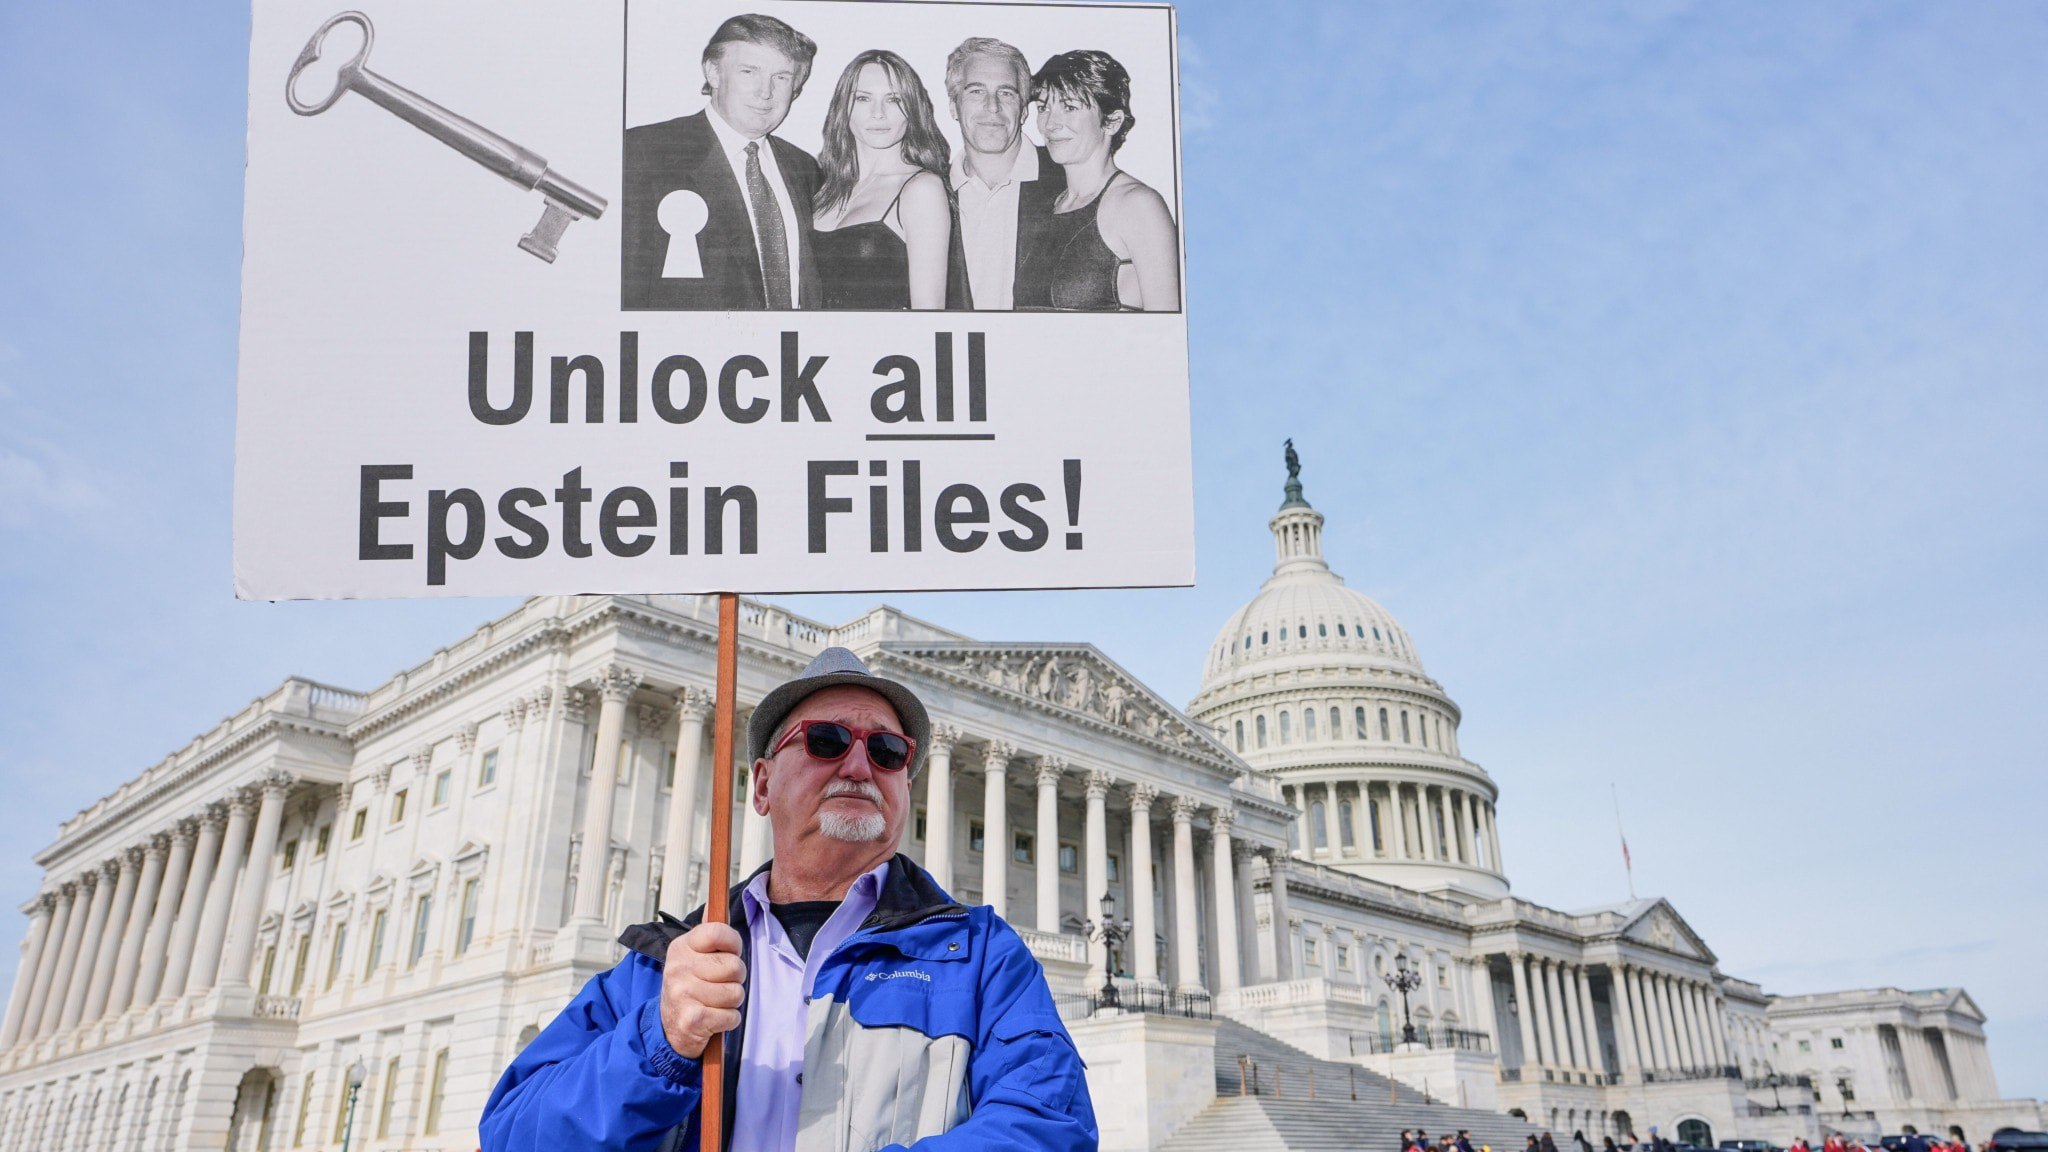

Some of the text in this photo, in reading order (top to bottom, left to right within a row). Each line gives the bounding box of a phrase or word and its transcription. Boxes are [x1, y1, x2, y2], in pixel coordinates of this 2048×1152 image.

[468, 331, 988, 426] Unlock all
[358, 459, 1083, 586] Epstein Files!
[878, 970, 931, 982] Columbia
